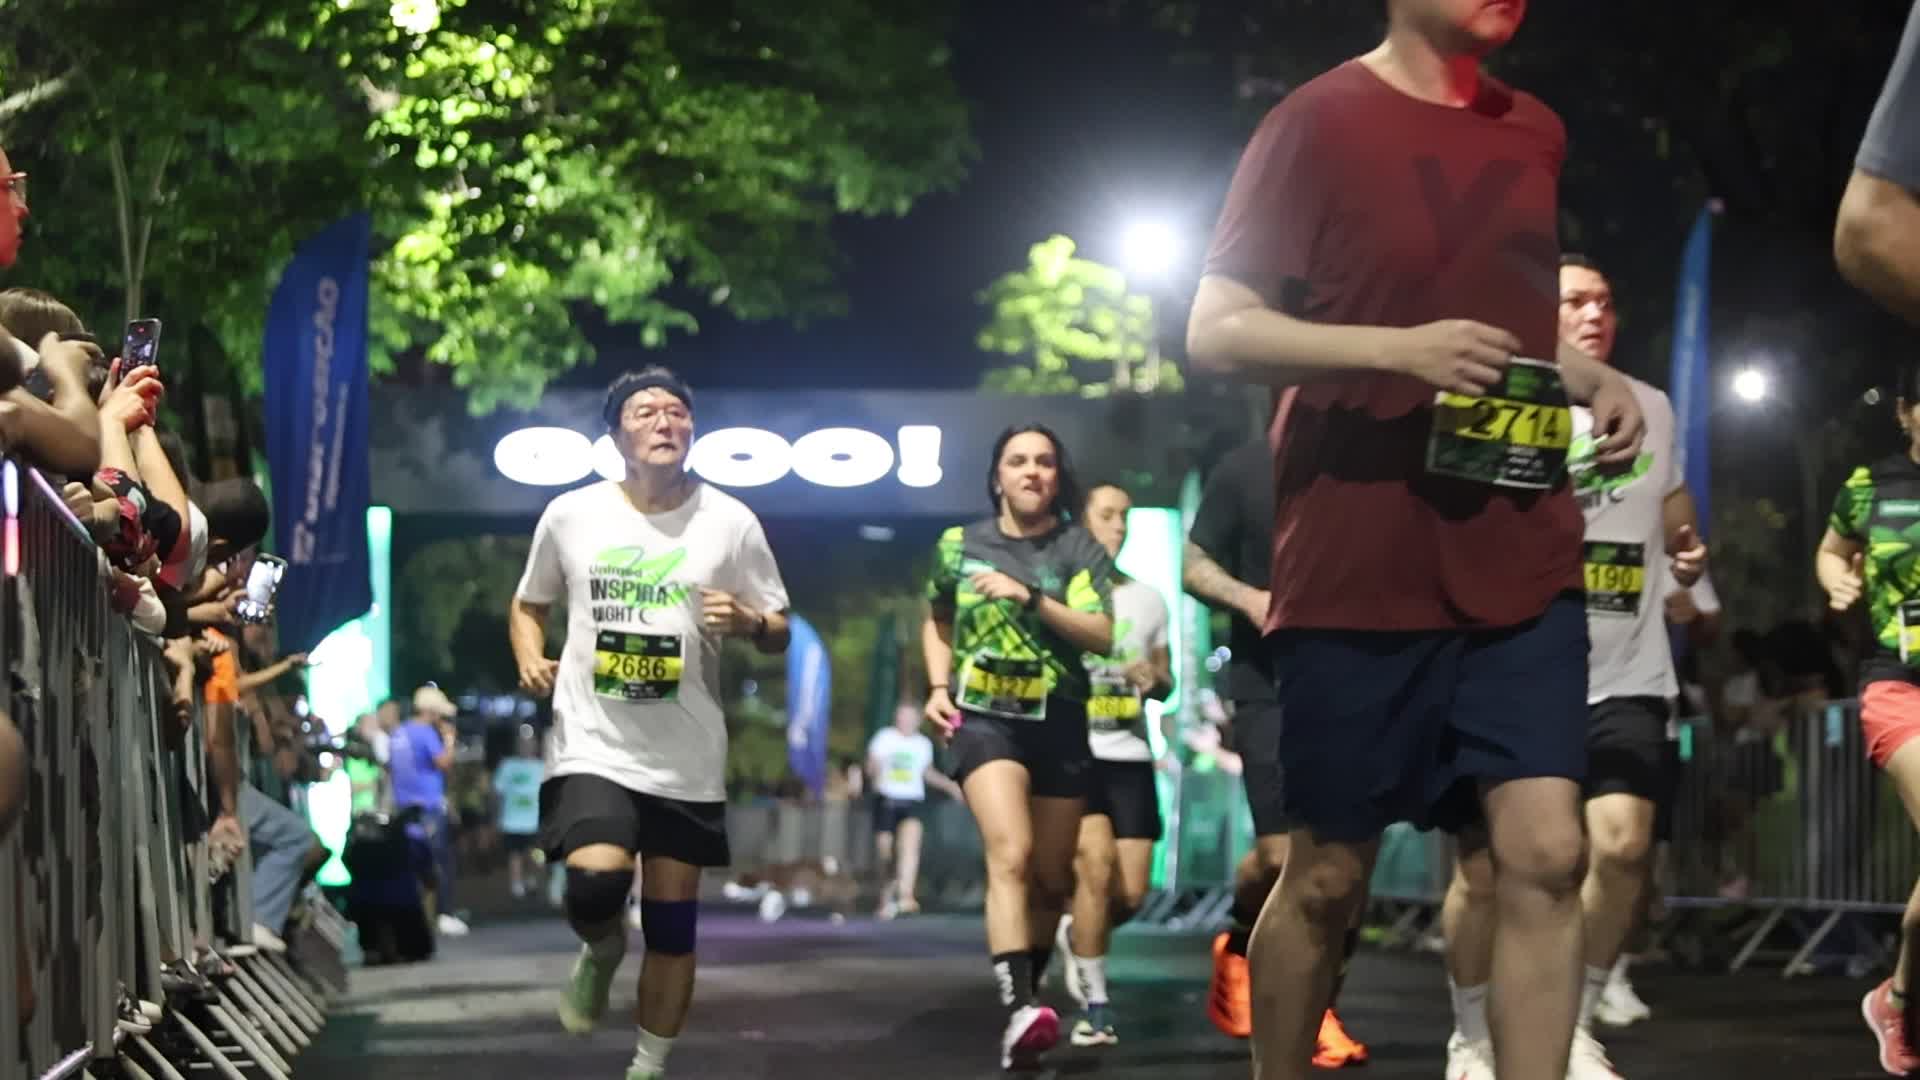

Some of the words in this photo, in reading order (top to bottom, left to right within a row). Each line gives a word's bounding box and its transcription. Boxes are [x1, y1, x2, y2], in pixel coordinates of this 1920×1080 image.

[1472, 399, 1560, 443] 2714
[589, 563, 643, 577] Unimed
[608, 654, 667, 679] 2686
